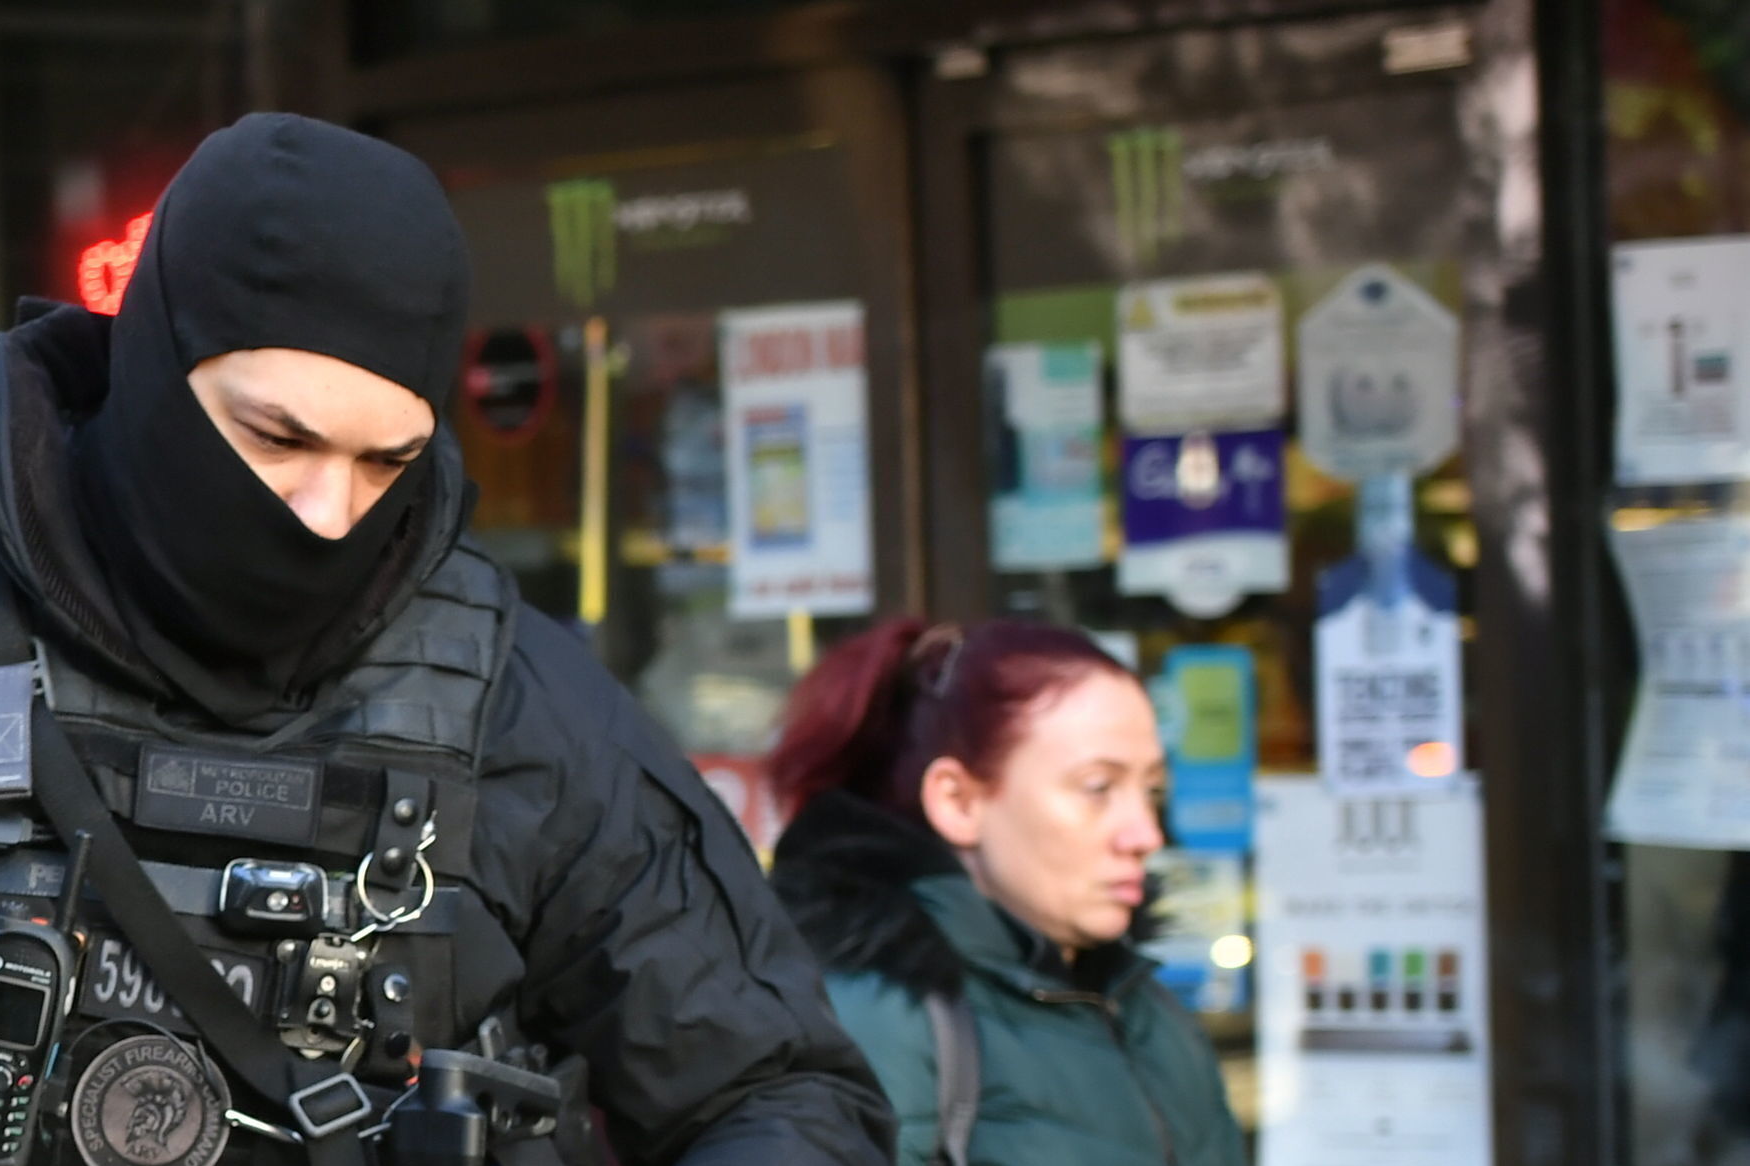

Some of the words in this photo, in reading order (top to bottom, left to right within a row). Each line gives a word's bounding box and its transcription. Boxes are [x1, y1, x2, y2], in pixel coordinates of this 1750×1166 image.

[215, 779, 290, 802] POLICE
[200, 802, 256, 827] ARV
[81, 1056, 123, 1152] SPECIALIST
